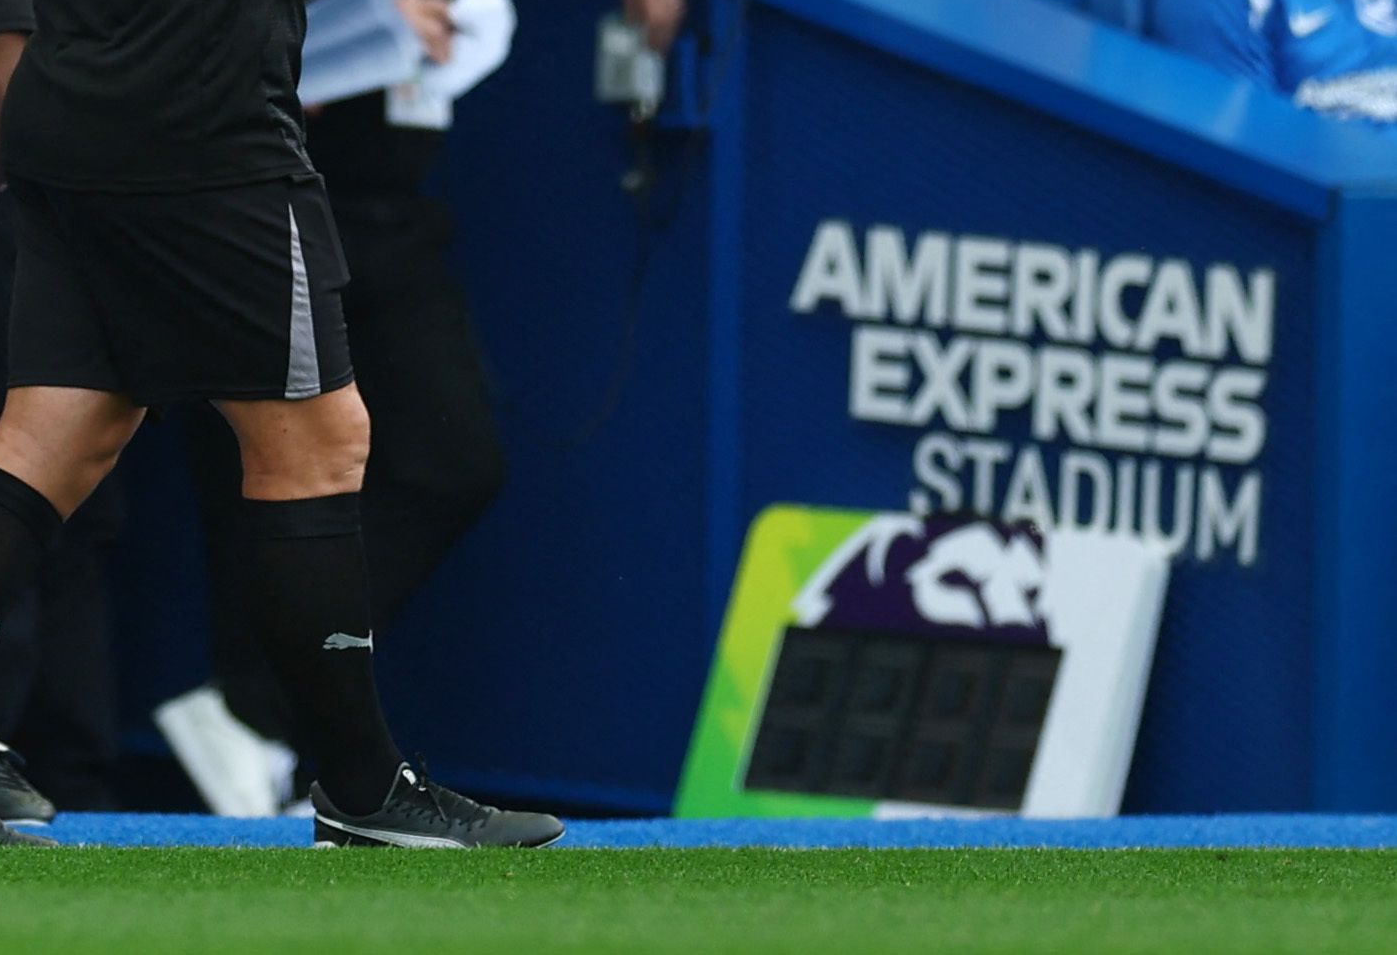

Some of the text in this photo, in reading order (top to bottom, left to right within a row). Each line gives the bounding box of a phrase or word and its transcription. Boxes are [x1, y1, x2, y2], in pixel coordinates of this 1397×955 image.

[789, 220, 1275, 364] AMERICAN
[848, 325, 1267, 464] EXPRESS
[908, 432, 1261, 566] STADIUM
